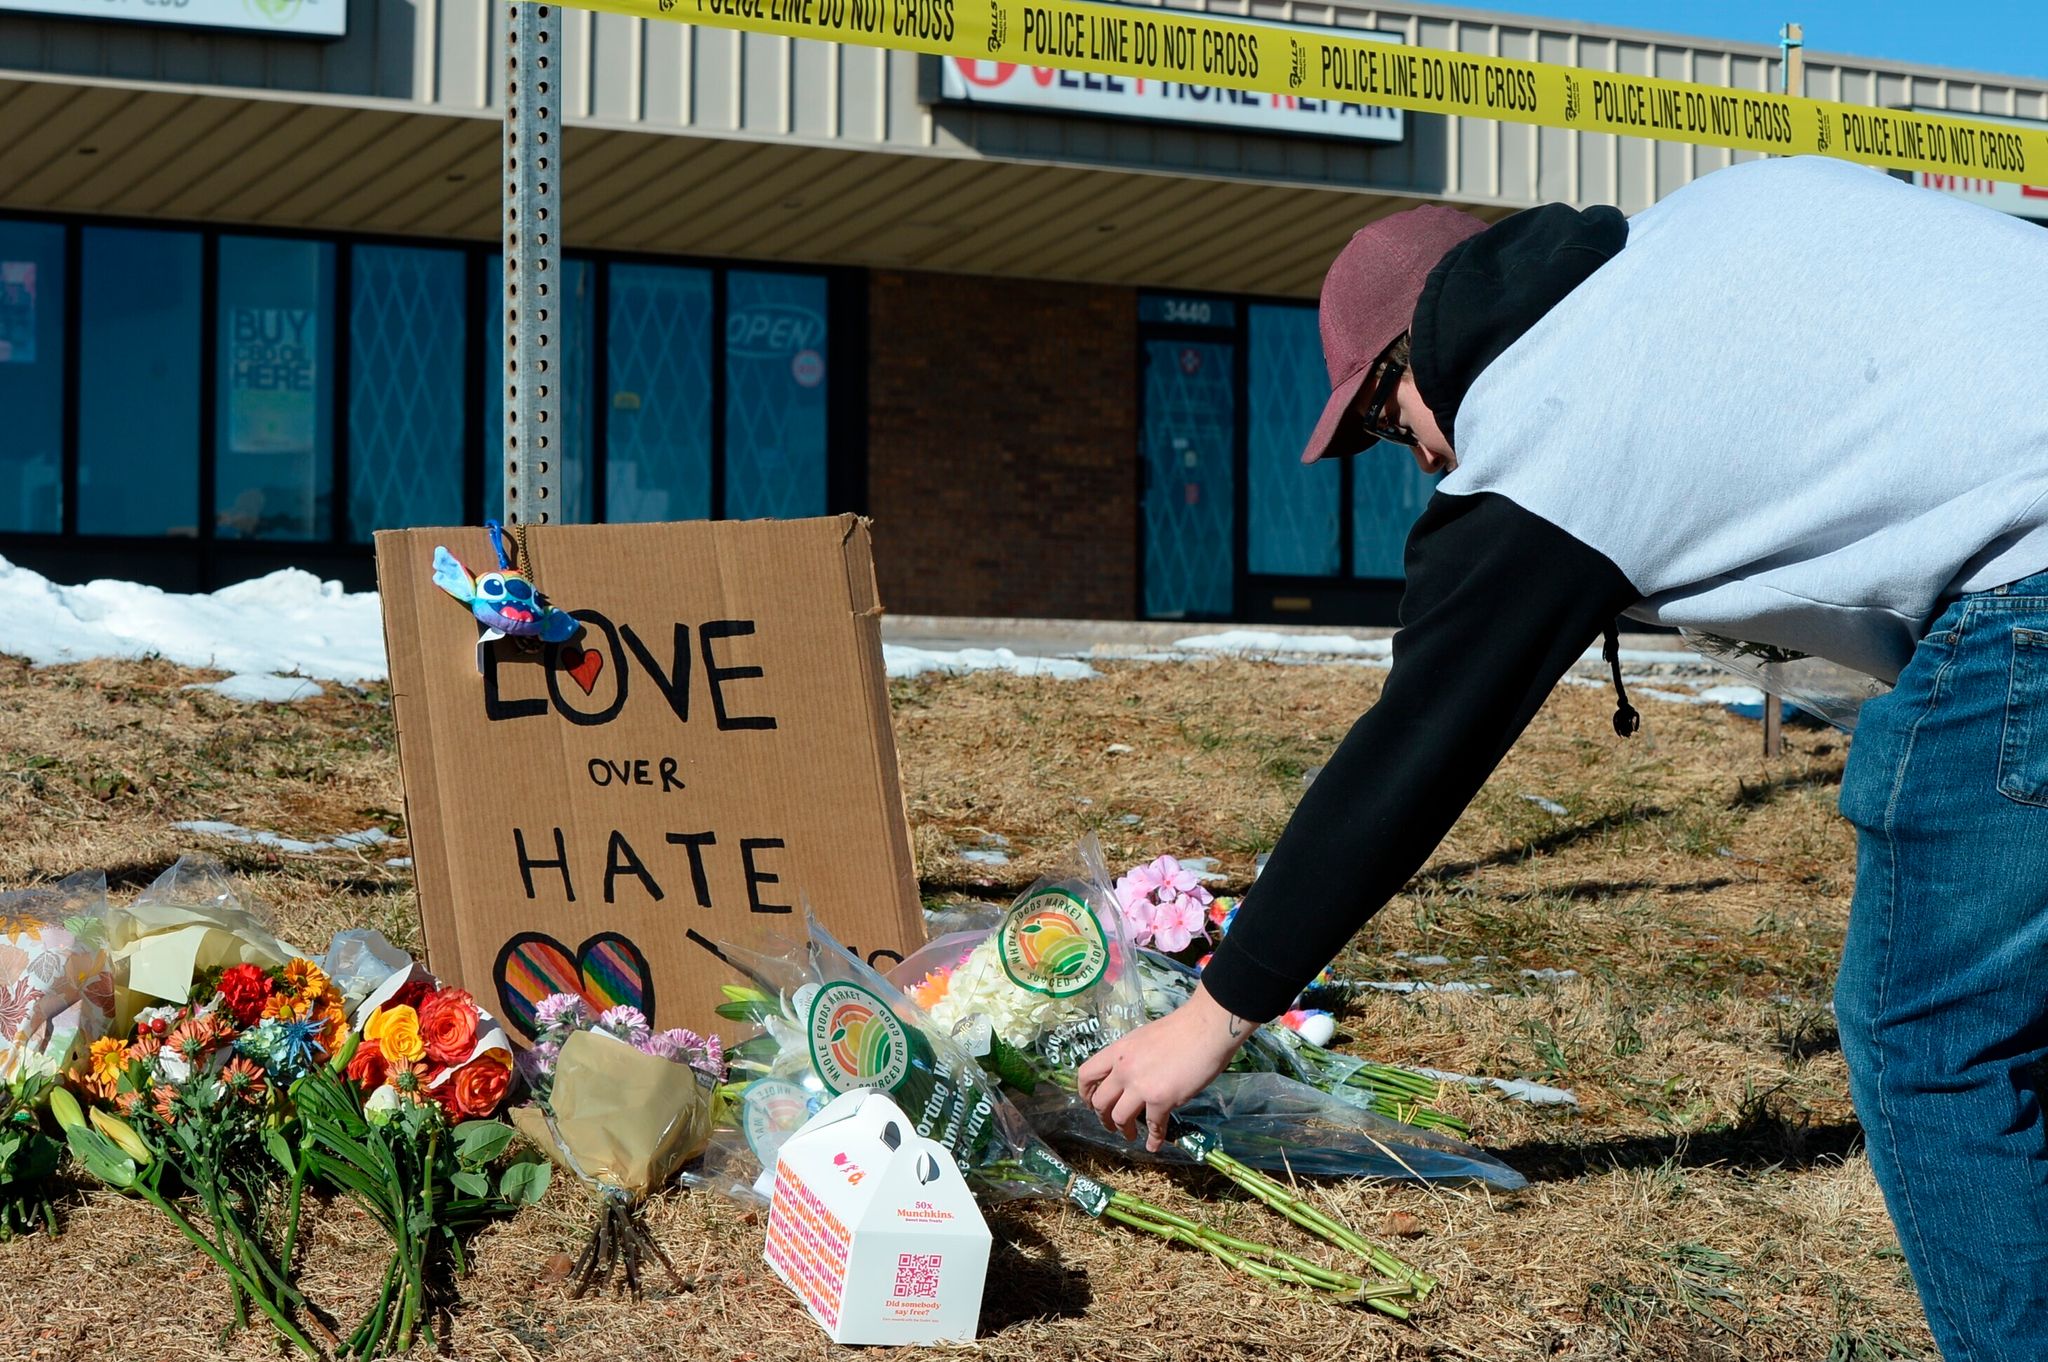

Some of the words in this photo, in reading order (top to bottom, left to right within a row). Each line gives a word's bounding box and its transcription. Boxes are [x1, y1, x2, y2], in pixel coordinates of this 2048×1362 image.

[819, 0, 844, 29] DO
[893, 0, 954, 42] CROSS
[1023, 8, 1084, 58] POLICE
[1091, 16, 1128, 63] LINE
[1134, 21, 1157, 67] DO
[1163, 25, 1196, 71] NOT
[1203, 29, 1259, 79] CROSS
[1321, 45, 1377, 93] POLICE
[1383, 52, 1418, 98] LINE
[1422, 58, 1444, 101] DO
[1449, 61, 1479, 105] NOT
[1485, 65, 1537, 112] CROSS
[1593, 80, 1646, 126] POLICE
[1648, 87, 1683, 130] LINE
[1686, 92, 1706, 134] DO
[1712, 95, 1739, 137] NOT
[1743, 99, 1792, 144] CROSS
[1842, 112, 1891, 156] POLICE
[1893, 119, 1925, 161] LINE
[1926, 123, 1947, 164] DO
[1949, 126, 1977, 167] NOT
[1980, 129, 2025, 173] CROSS
[235, 308, 310, 342] BUY
[1164, 301, 1211, 323] 3440
[728, 313, 814, 349] OPEN
[235, 362, 313, 391] HERE
[478, 609, 777, 731] LOVE
[588, 757, 685, 792] OVER
[513, 827, 792, 913] HATE
[1014, 899, 1041, 925] FOODS
[1044, 897, 1082, 921] MARKET
[1009, 926, 1021, 964] WHOLE
[1074, 964, 1095, 984] FOR
[827, 989, 861, 1006] MARKET
[816, 1003, 832, 1040] FOODS
[879, 1009, 901, 1038] GOOD
[818, 1044, 841, 1083] WHOLE
[894, 1041, 904, 1064] FOR
[916, 1081, 949, 1138] orting
[1035, 1149, 1068, 1175] FOODS
[915, 1201, 932, 1209] 50x
[901, 1301, 941, 1309] somebody
